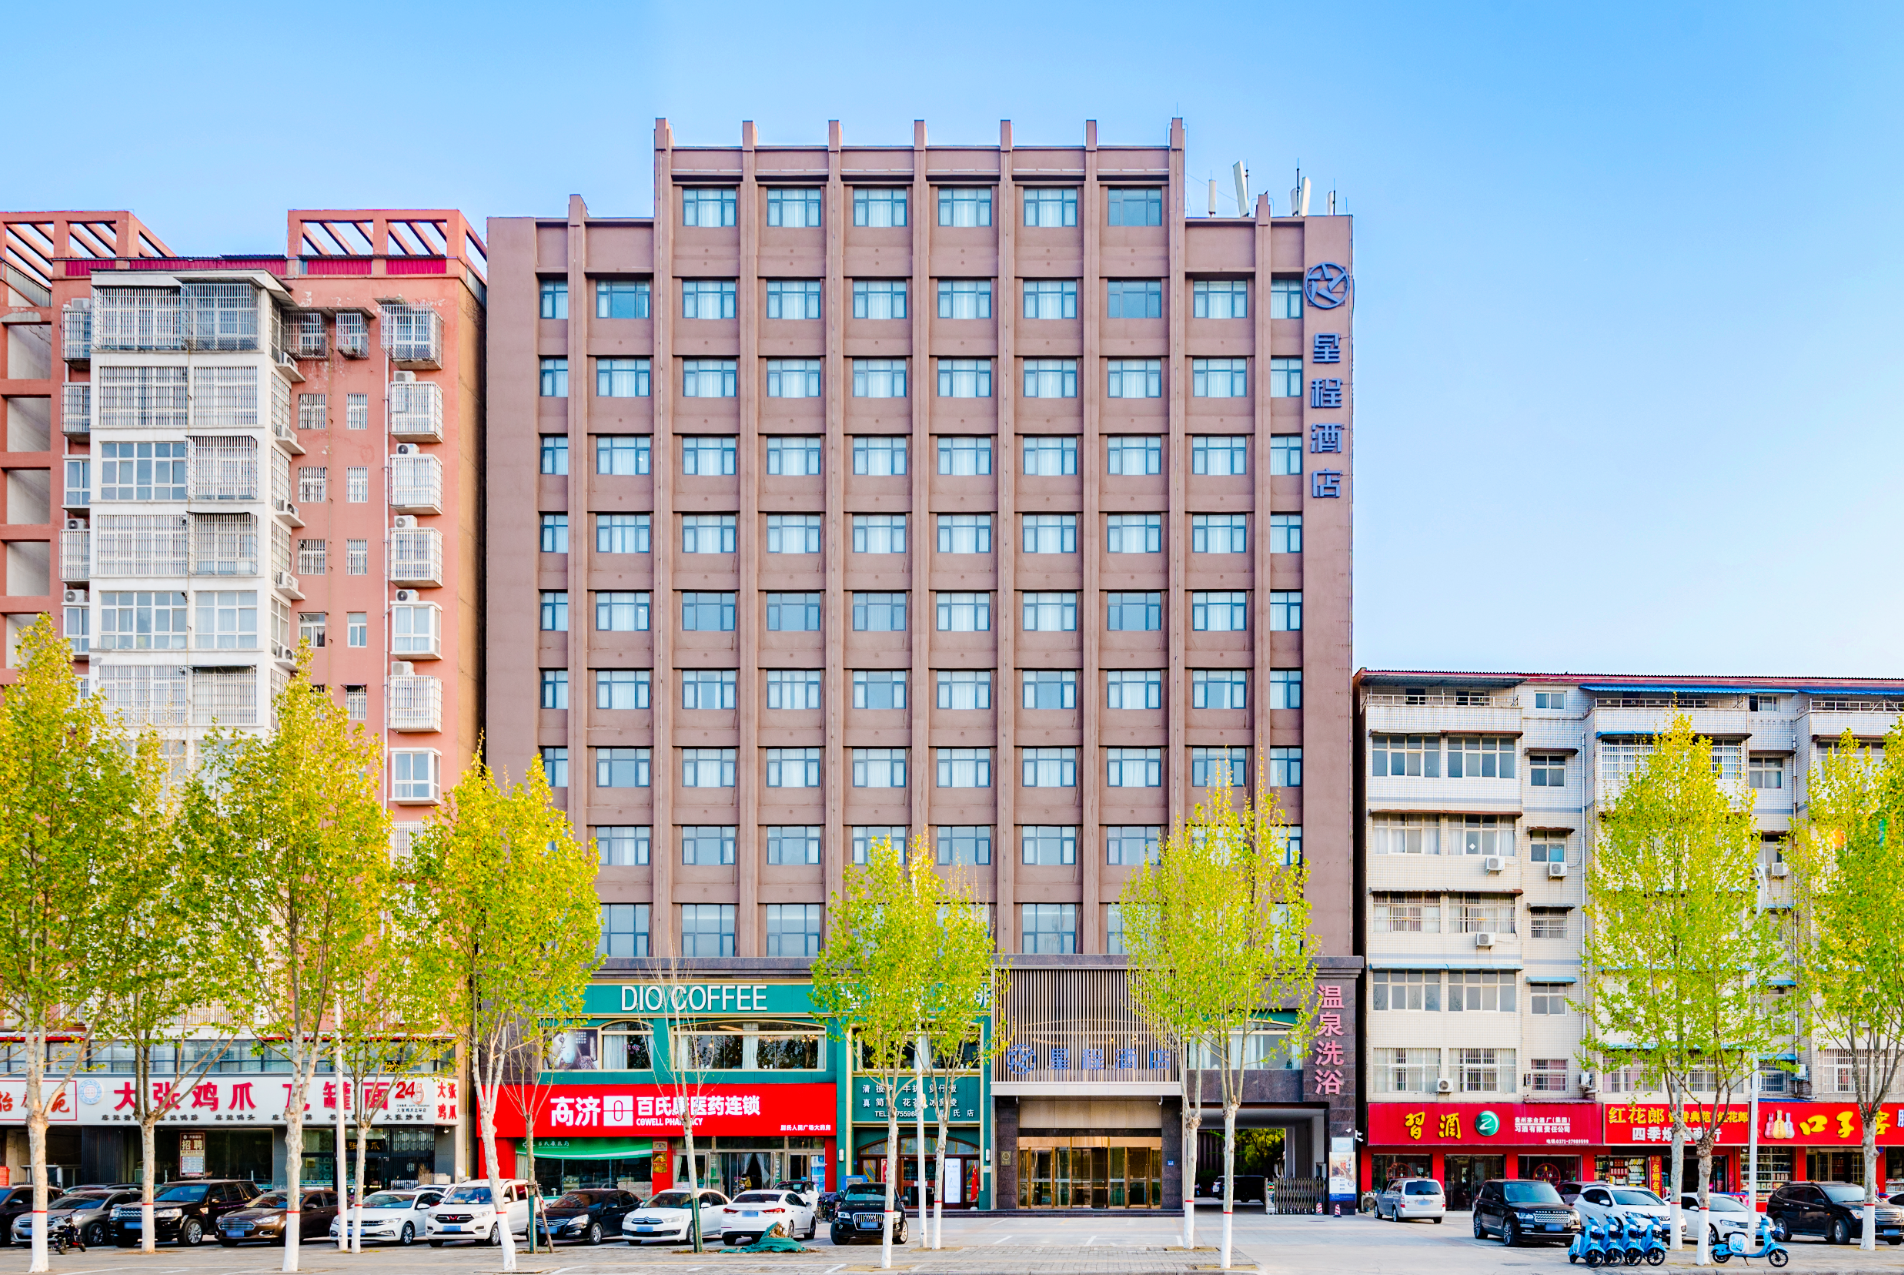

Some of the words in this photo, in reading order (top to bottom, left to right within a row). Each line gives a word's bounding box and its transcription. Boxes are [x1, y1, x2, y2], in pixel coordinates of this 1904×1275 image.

[1310, 332, 1343, 499] 星程酒店
[621, 985, 662, 1012] DIO
[671, 985, 768, 1012] COFFEE
[1314, 984, 1345, 1095] 温泉洗浴
[1050, 1048, 1170, 1070] 星程酒店
[114, 1081, 256, 1112] 大张鸡爪
[550, 1095, 601, 1127] 高济
[636, 1095, 761, 1116] 百氏康医药连锁
[665, 1117, 703, 1126] PHAACY
[1608, 1106, 1665, 1124] 红花郎
[1514, 1125, 1571, 1133] 习酒有限责任公司
